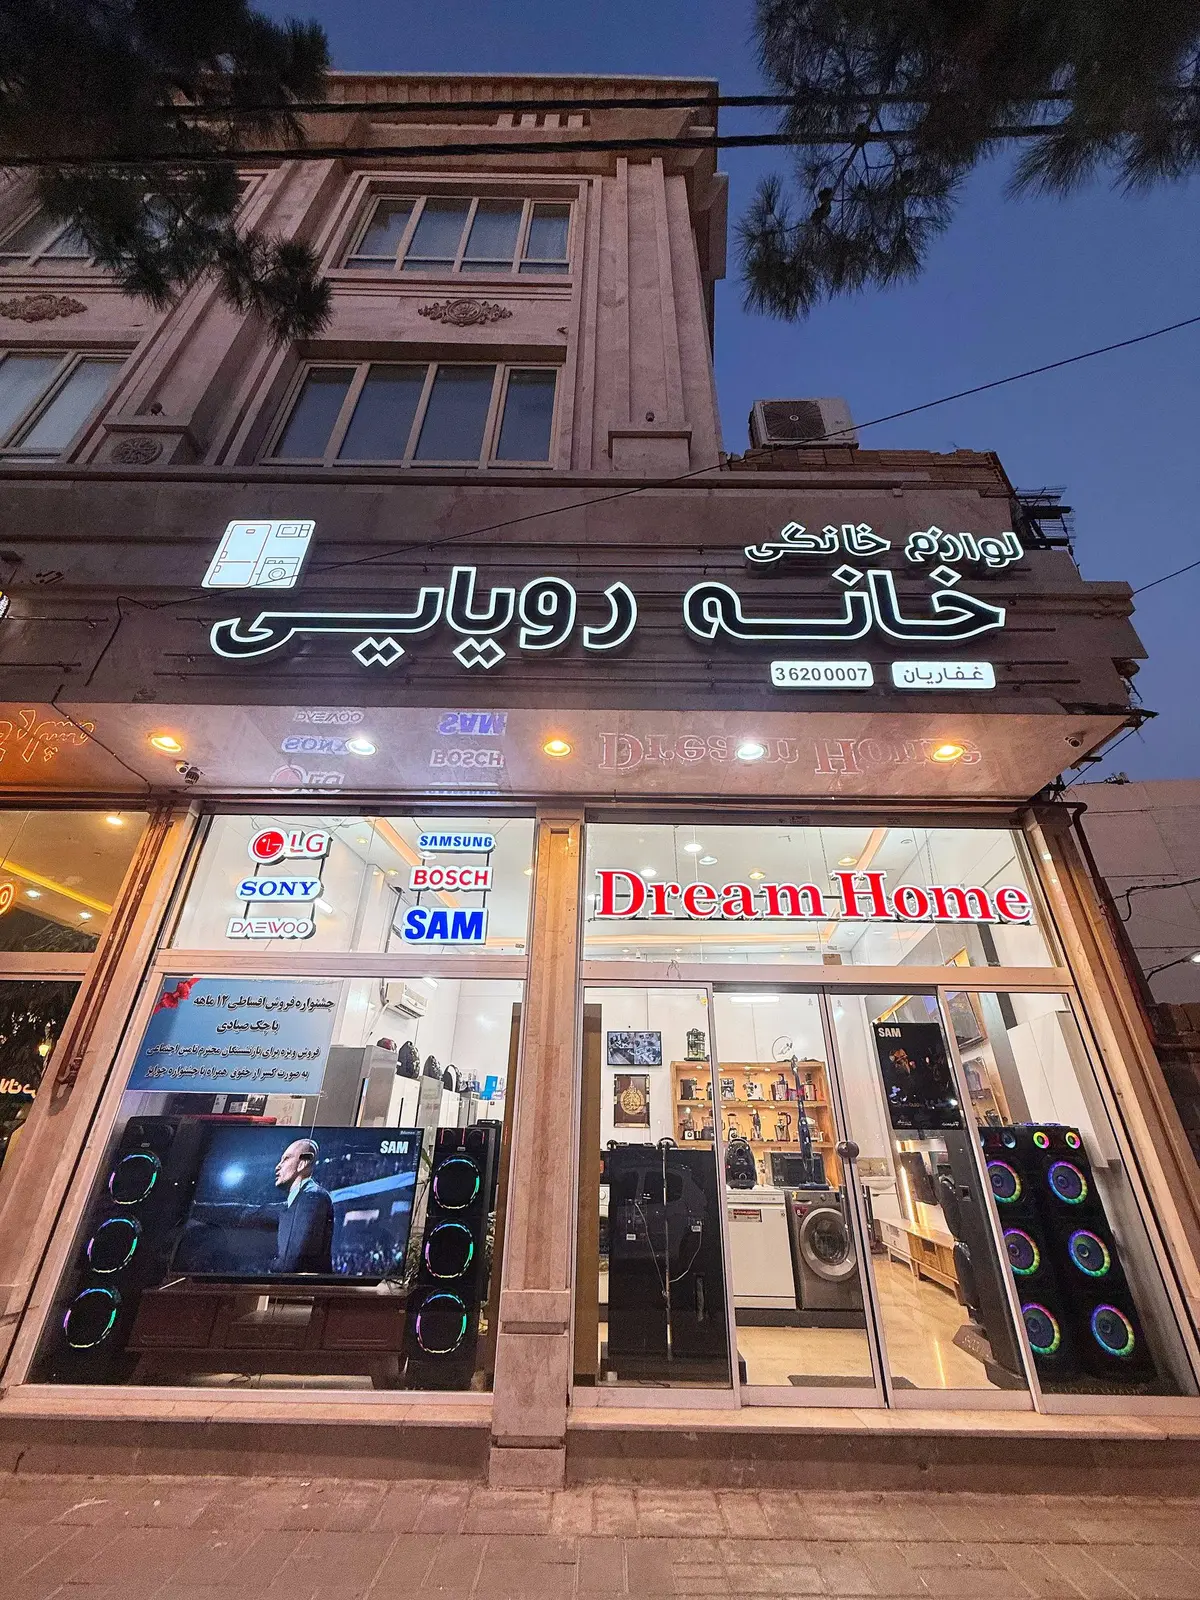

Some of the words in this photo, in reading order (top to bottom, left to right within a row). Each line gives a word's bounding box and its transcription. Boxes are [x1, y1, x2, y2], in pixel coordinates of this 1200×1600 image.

[744, 521, 891, 563] خانگی
[904, 525, 1025, 568] لوازم
[683, 564, 1006, 641] خانه
[210, 565, 638, 670] رویایی
[775, 667, 868, 682] 36200007
[903, 666, 984, 685] غفاریان
[289, 832, 324, 853] LG
[419, 835, 493, 848] SAMSUNG
[412, 869, 489, 887] BOSCH
[239, 880, 318, 896] SONY
[595, 870, 827, 918] Dream
[835, 871, 1032, 921] Home
[230, 921, 310, 934] DAEWOO
[404, 909, 484, 940] SAM
[265, 996, 295, 1012] فروش
[295, 997, 335, 1012] جشنواره
[877, 1027, 902, 1039] SAM
[379, 1140, 409, 1154] SAM
